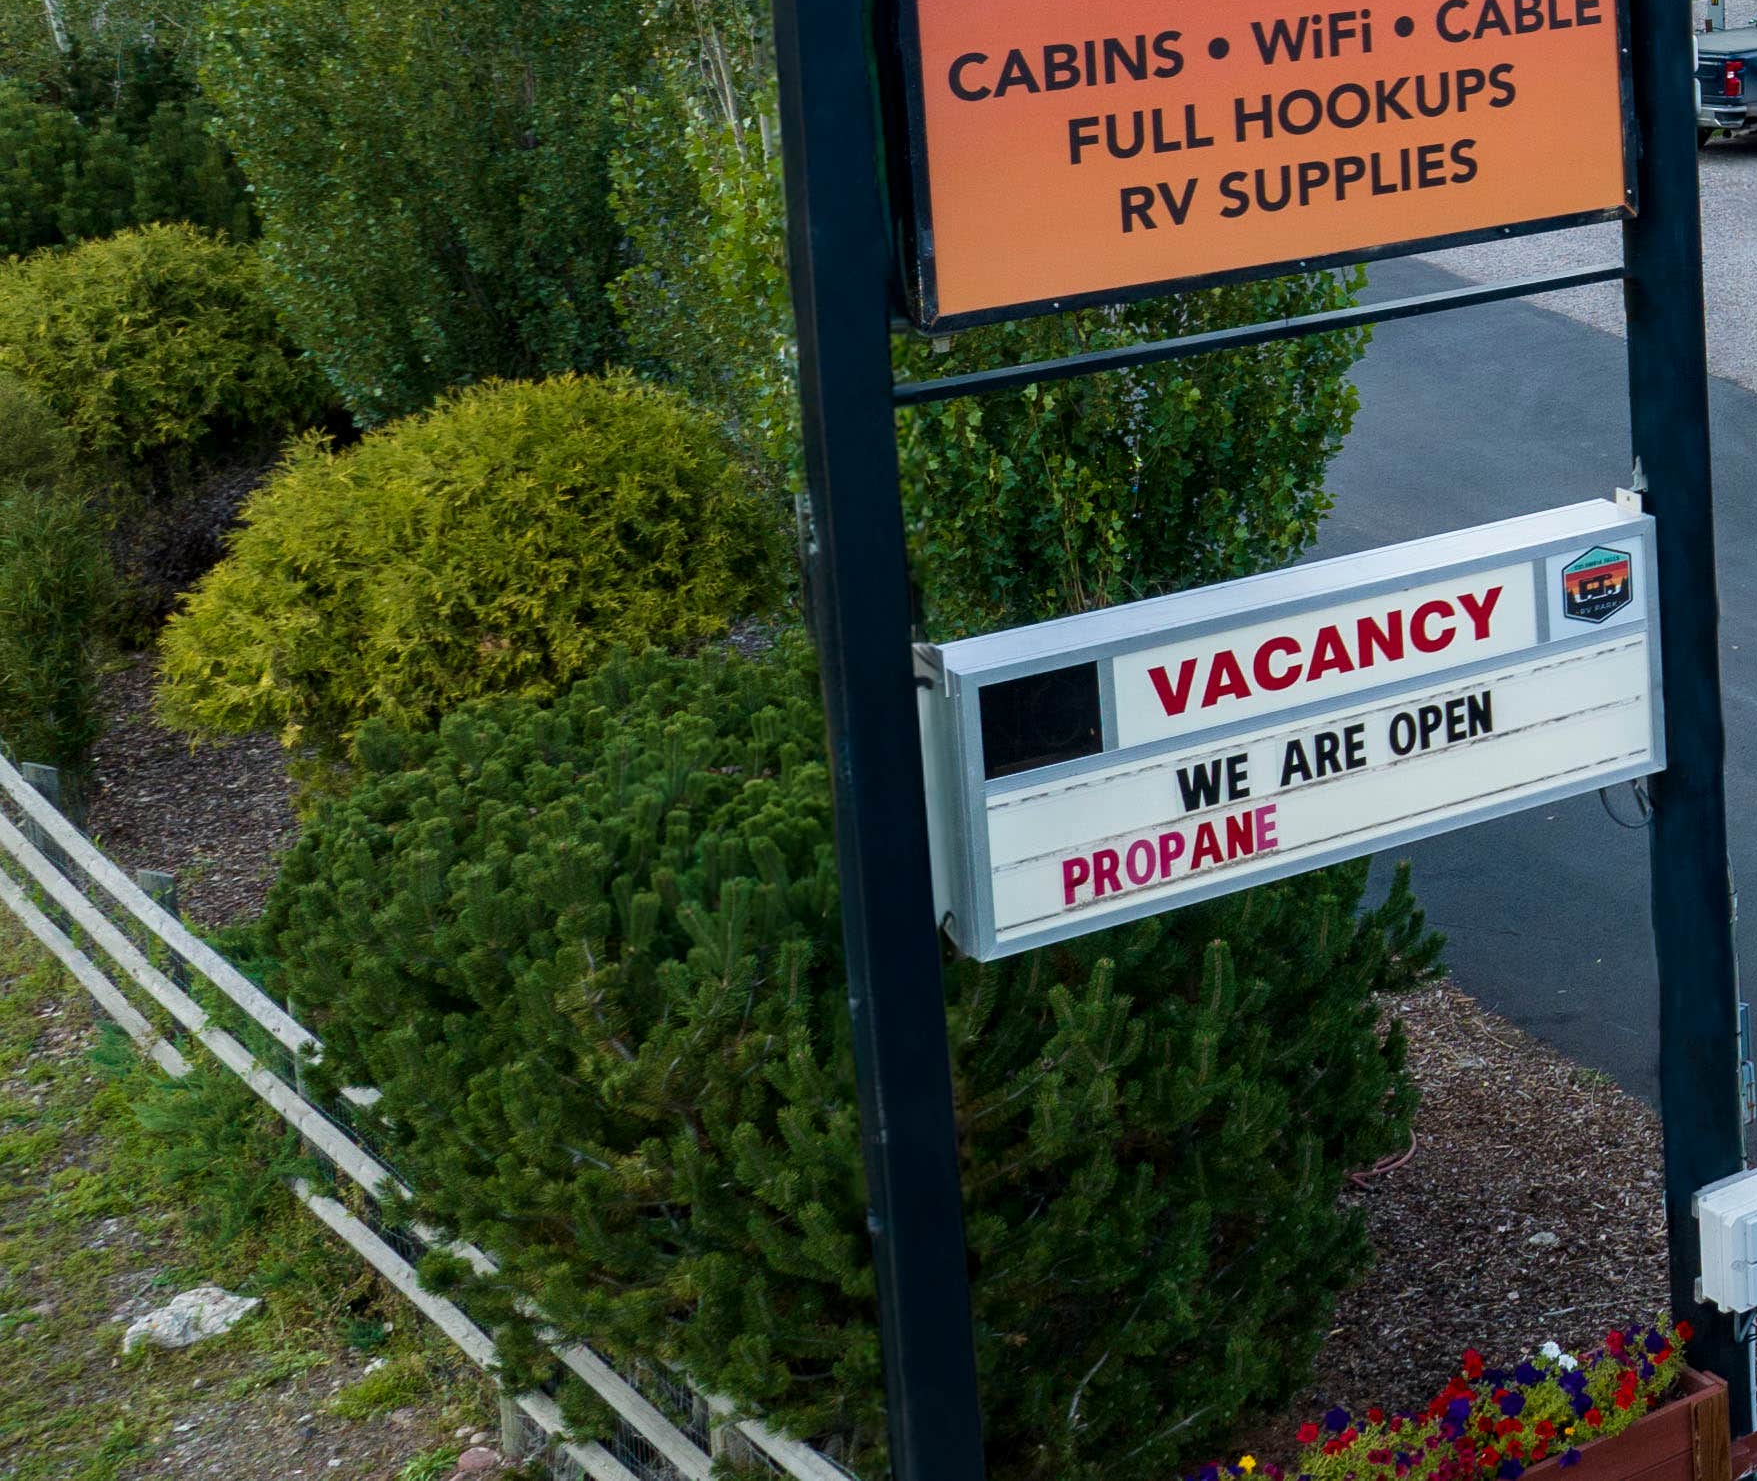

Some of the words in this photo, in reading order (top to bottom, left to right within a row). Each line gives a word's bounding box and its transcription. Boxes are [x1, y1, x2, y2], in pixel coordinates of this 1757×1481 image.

[948, 29, 1184, 103] CABINS
[1251, 9, 1372, 67] WiFi
[1067, 109, 1214, 165] FULL
[1234, 61, 1517, 143] HOOKUPS
[1119, 179, 1198, 233] RV
[1219, 138, 1478, 219] SUPPLIES
[1148, 585, 1504, 717] VACANCY
[1176, 754, 1250, 813] WE
[1280, 723, 1367, 788] ARE
[1389, 690, 1494, 757] OPEN
[1062, 803, 1279, 906] PROPANE
